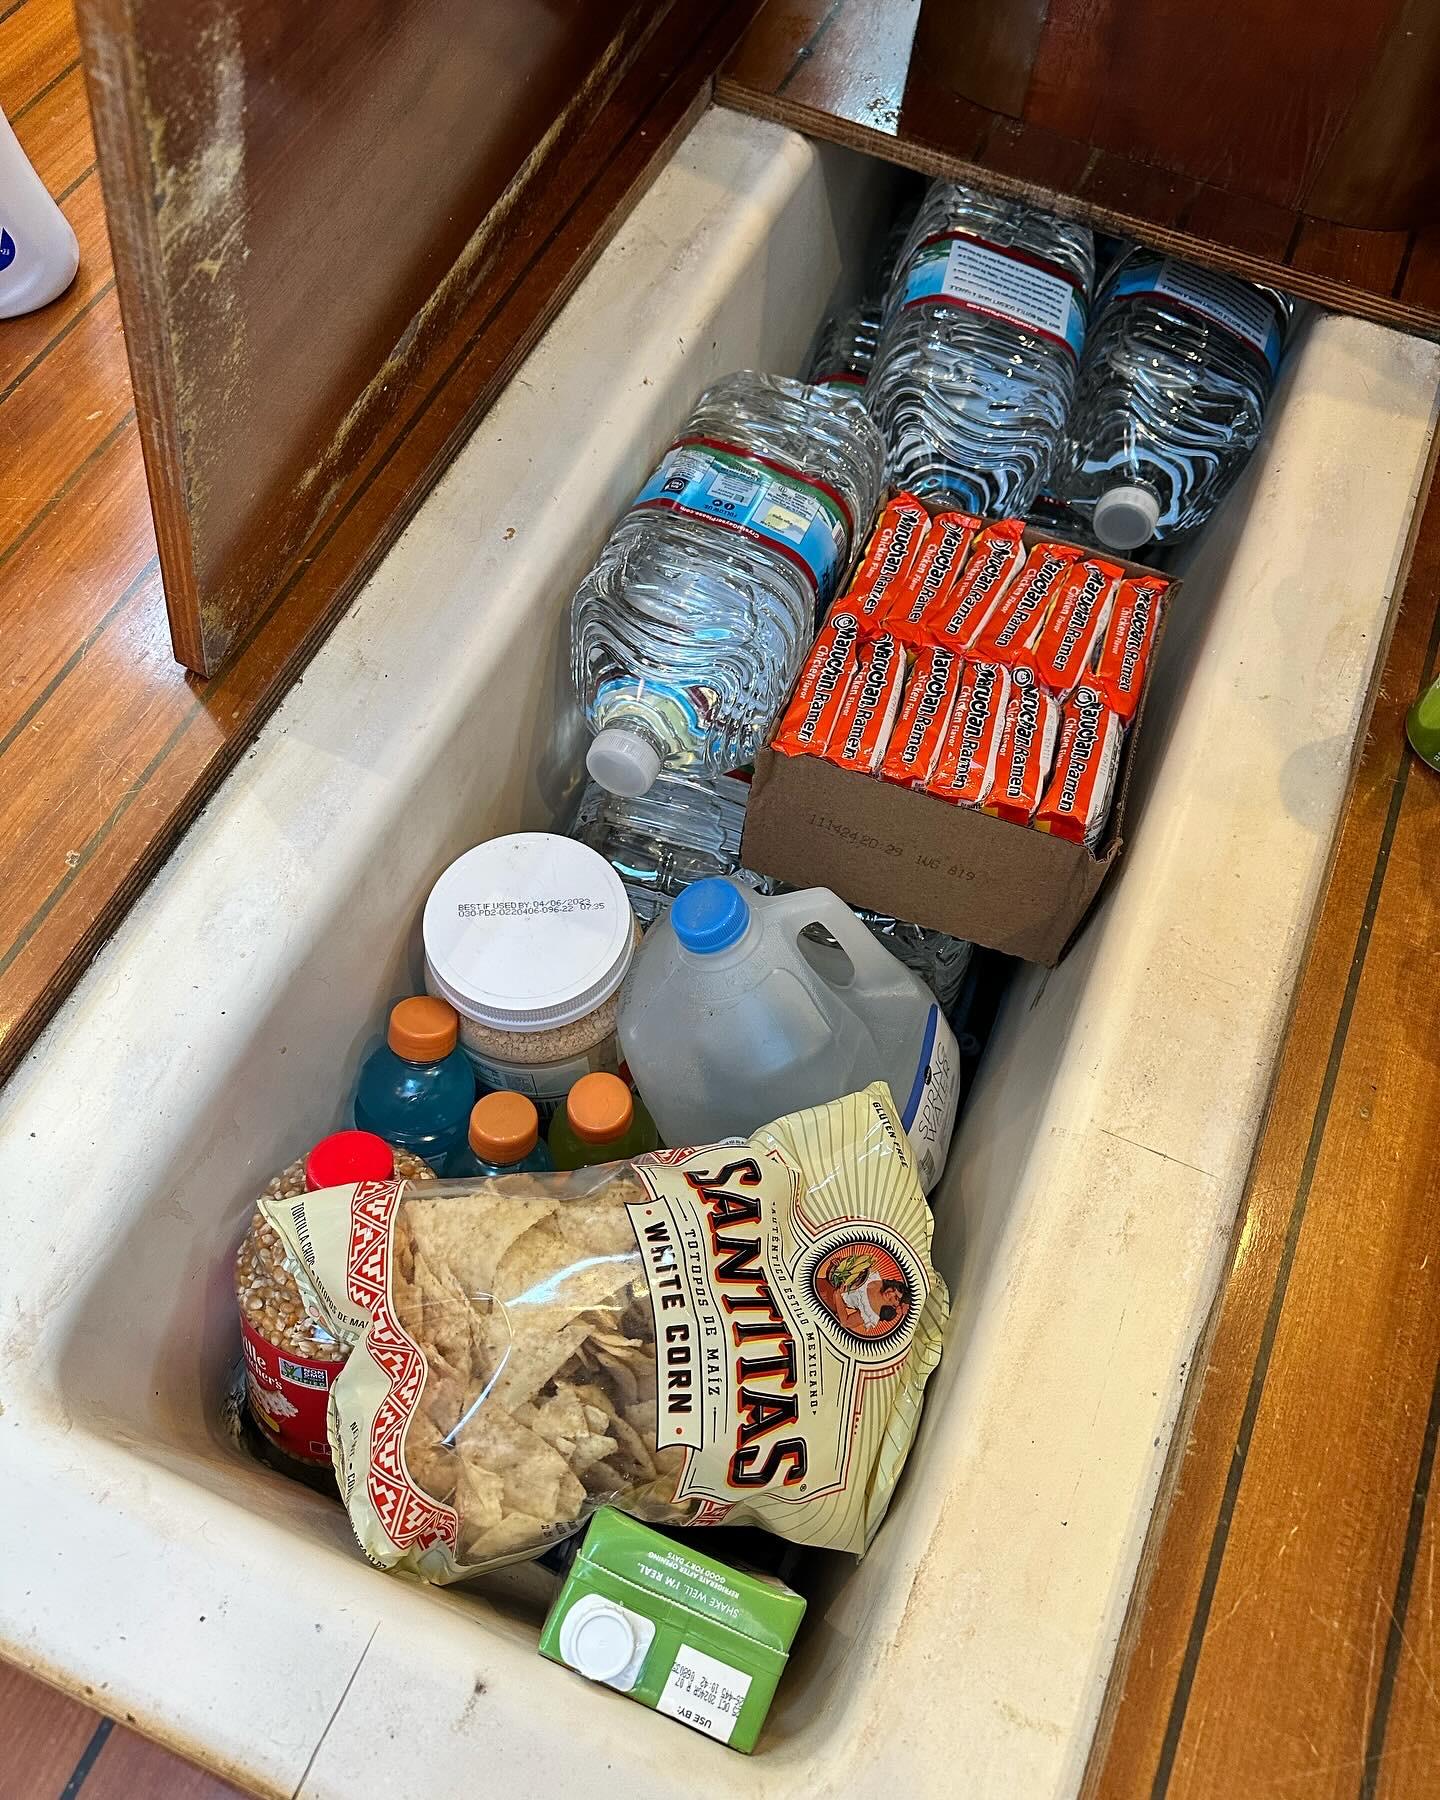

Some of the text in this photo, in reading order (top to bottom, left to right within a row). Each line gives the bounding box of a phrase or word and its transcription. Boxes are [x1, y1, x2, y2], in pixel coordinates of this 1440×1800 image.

[946, 591, 981, 633] Ramen
[997, 610, 1029, 646] Ramen
[1053, 628, 1081, 670] Ramen
[1120, 650, 1139, 691] Ramen
[800, 627, 857, 741] Maruchan Ramen
[844, 708, 872, 758] Ramen
[903, 716, 932, 762] Ramen
[1008, 748, 1030, 797] Ramen
[1060, 759, 1087, 811] Ramen
[873, 1102, 908, 1168] GLUTEN FREE
[291, 1201, 310, 1244] TORTILLA
[315, 1276, 338, 1314] TOTOPOS
[337, 1311, 348, 1323] DE
[643, 1220, 694, 1416] WHITE CORN
[683, 1157, 809, 1490] SANTITAS
[685, 1229, 721, 1397] TOTOPOS DE MAÍZ
[772, 1208, 818, 1408] AUTÉNTICO ESTILO MEXICANO
[648, 1551, 739, 1599] REFRIGERATE AFTER OPENING
[668, 1552, 685, 1565] DAYS
[692, 1564, 704, 1574] FOR
[705, 1570, 726, 1584] GOOD
[638, 1563, 739, 1618] SHAKE WELL. I'M REAL.
[677, 1706, 712, 1728] USE BY:
[717, 1700, 730, 1712] OCT
